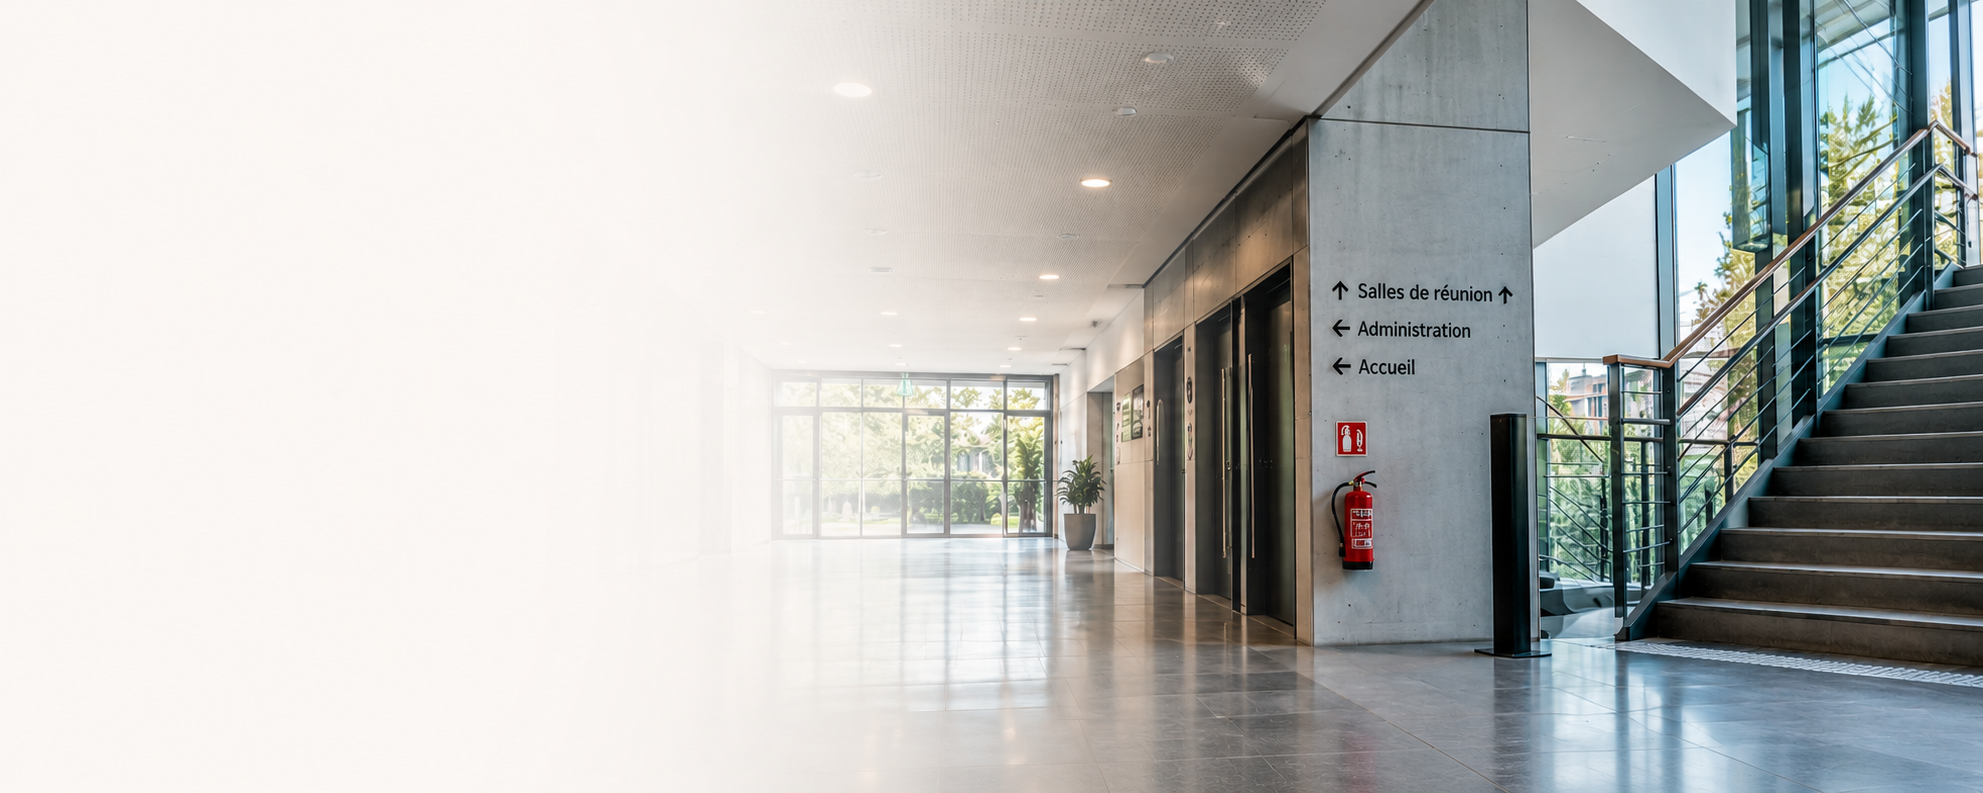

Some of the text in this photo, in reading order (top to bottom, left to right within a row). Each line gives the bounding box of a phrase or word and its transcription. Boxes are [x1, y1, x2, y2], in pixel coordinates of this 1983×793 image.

[1358, 283, 1493, 302] Salles de réunion
[1358, 321, 1471, 338] Administration
[1358, 359, 1416, 375] Accueil
